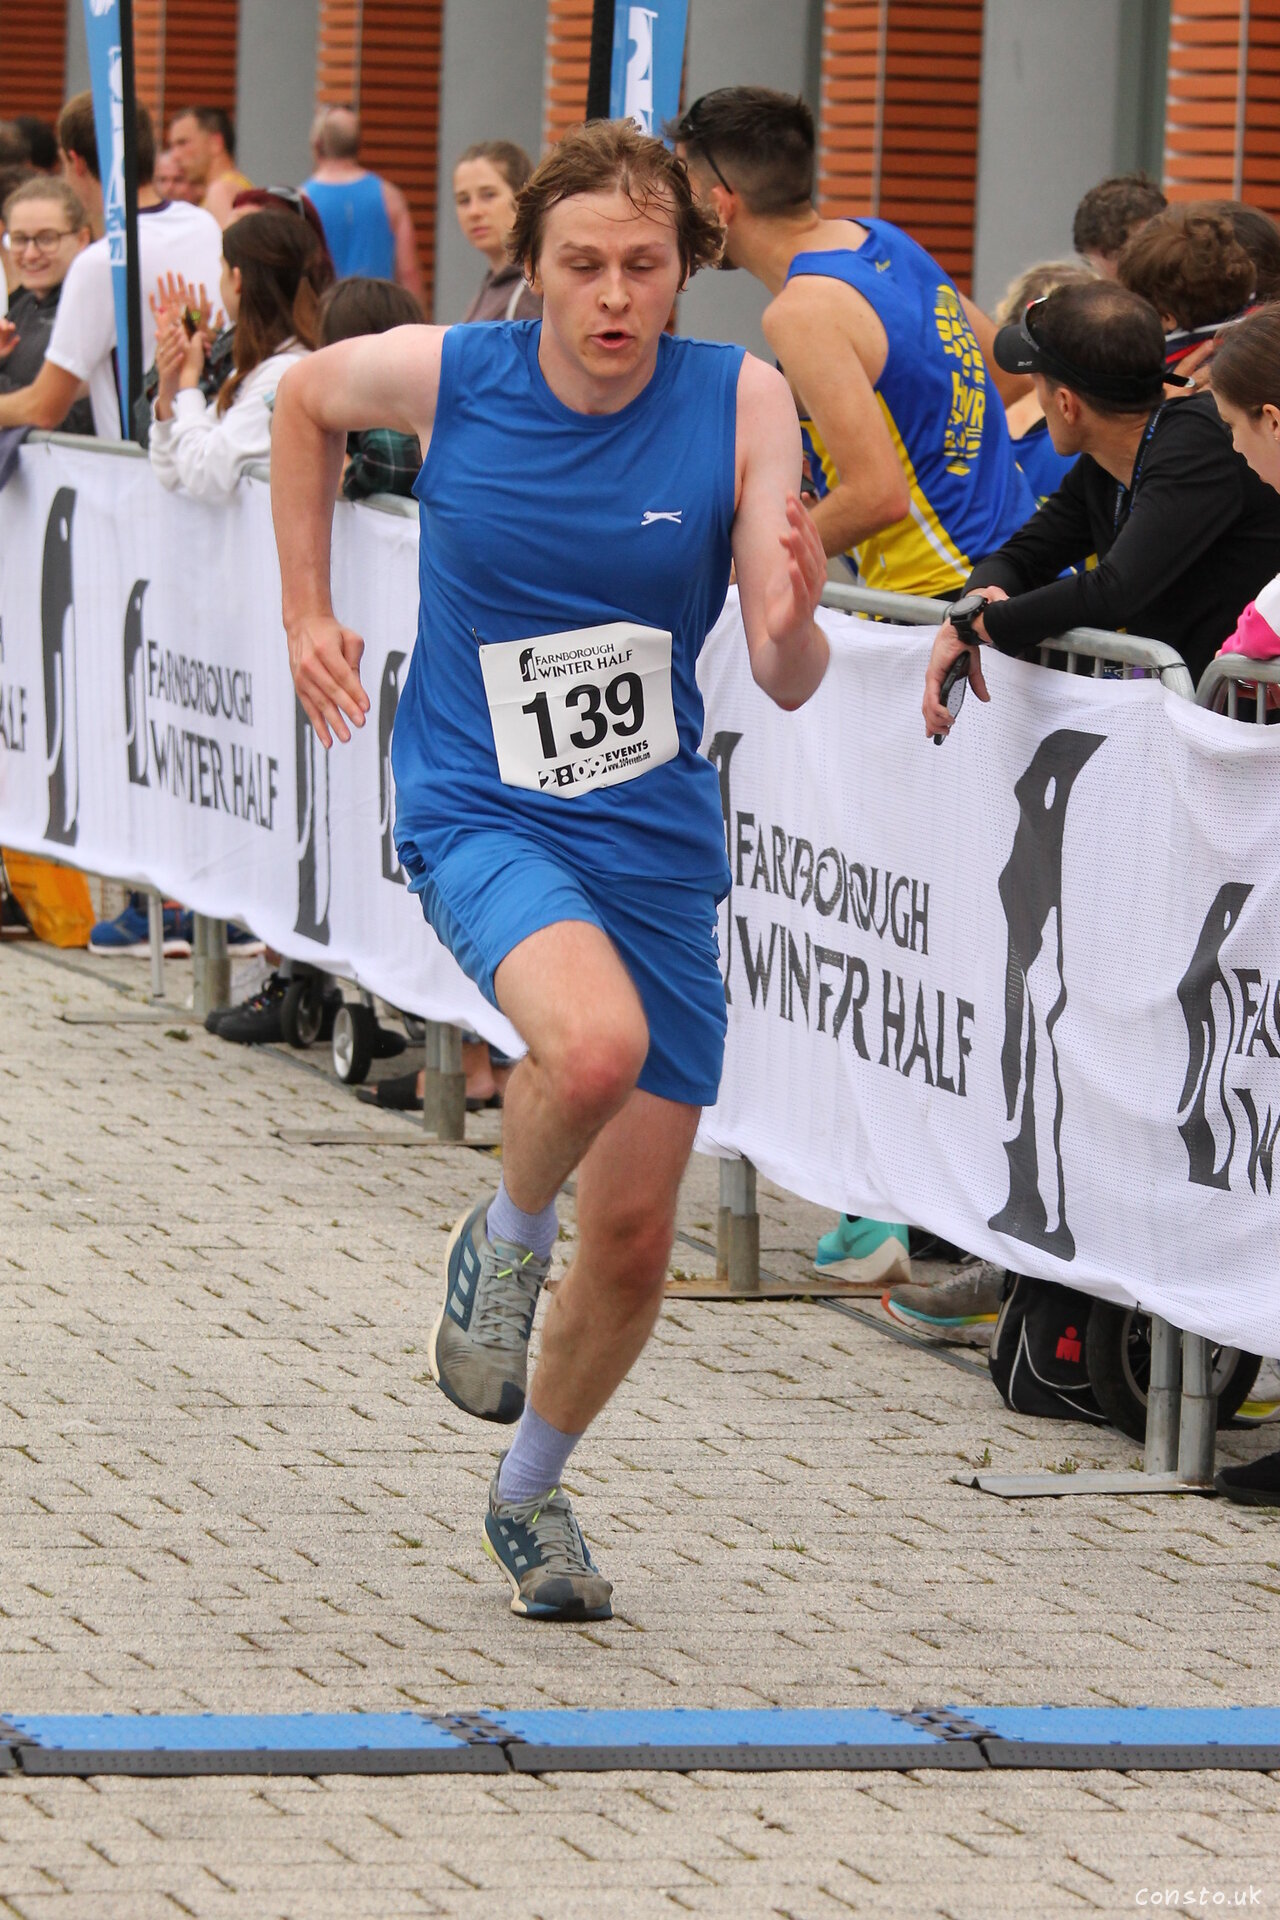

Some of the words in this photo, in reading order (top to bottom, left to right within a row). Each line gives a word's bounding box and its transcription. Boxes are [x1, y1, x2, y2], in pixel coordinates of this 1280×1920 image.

[148, 640, 253, 727] FARNBOROUGH
[535, 643, 615, 666] FARNBOROUGH
[537, 658, 594, 680] WINTER
[599, 649, 633, 670] HALF
[521, 671, 645, 759] 139
[605, 740, 649, 761] EVENTS
[150, 719, 231, 814] WINTER
[230, 743, 278, 831] HALF
[879, 969, 975, 1097] HALF
